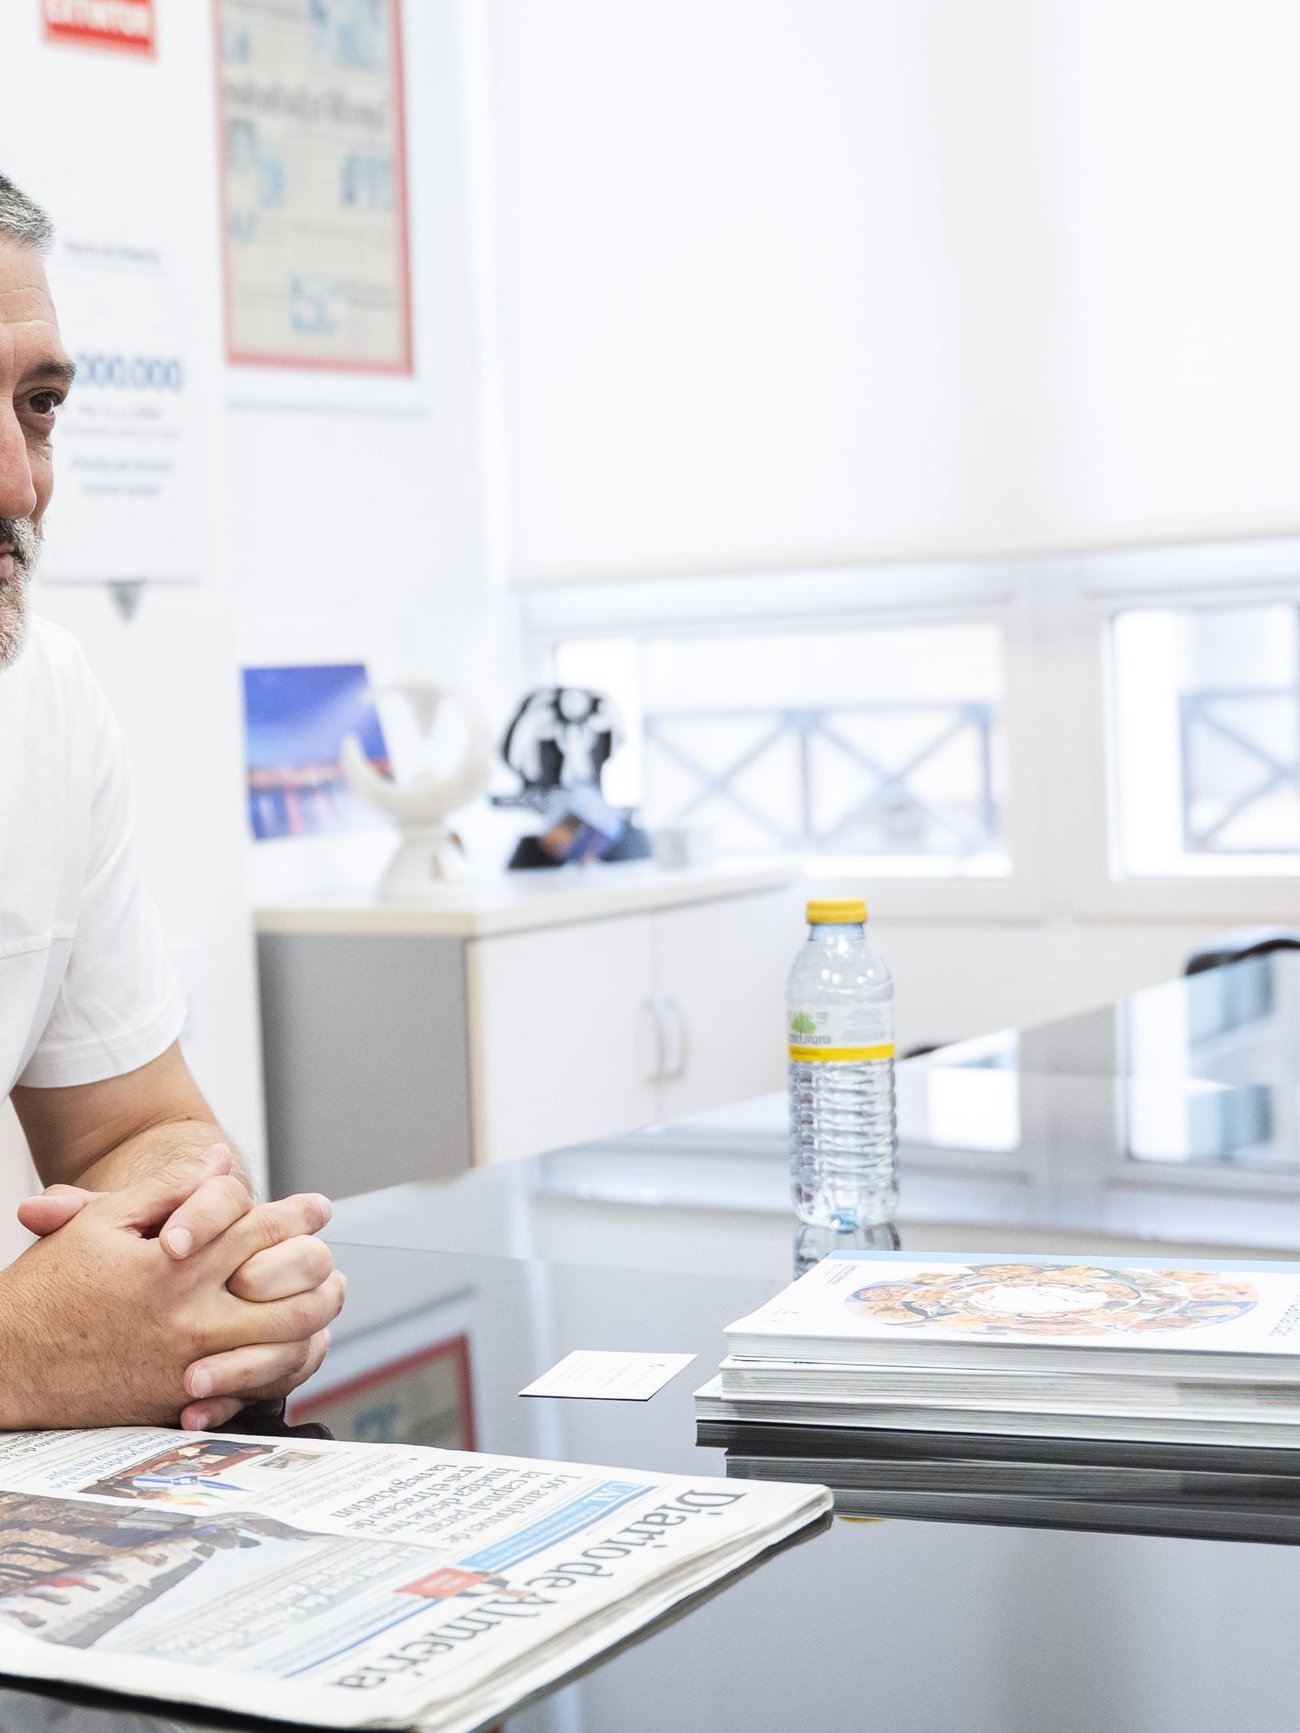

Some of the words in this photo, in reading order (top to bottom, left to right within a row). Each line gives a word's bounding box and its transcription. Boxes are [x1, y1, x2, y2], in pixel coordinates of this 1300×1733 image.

[443, 1466, 483, 1482] tras
[452, 1468, 519, 1496] huelga
[540, 1475, 580, 1488] Los
[369, 1492, 439, 1519] fracaso
[468, 1480, 528, 1510] capital
[407, 1498, 463, 1519] desde
[463, 1490, 548, 1532] autobuses
[346, 1520, 377, 1529] de
[581, 1490, 747, 1559] Diario
[524, 1563, 613, 1588] de
